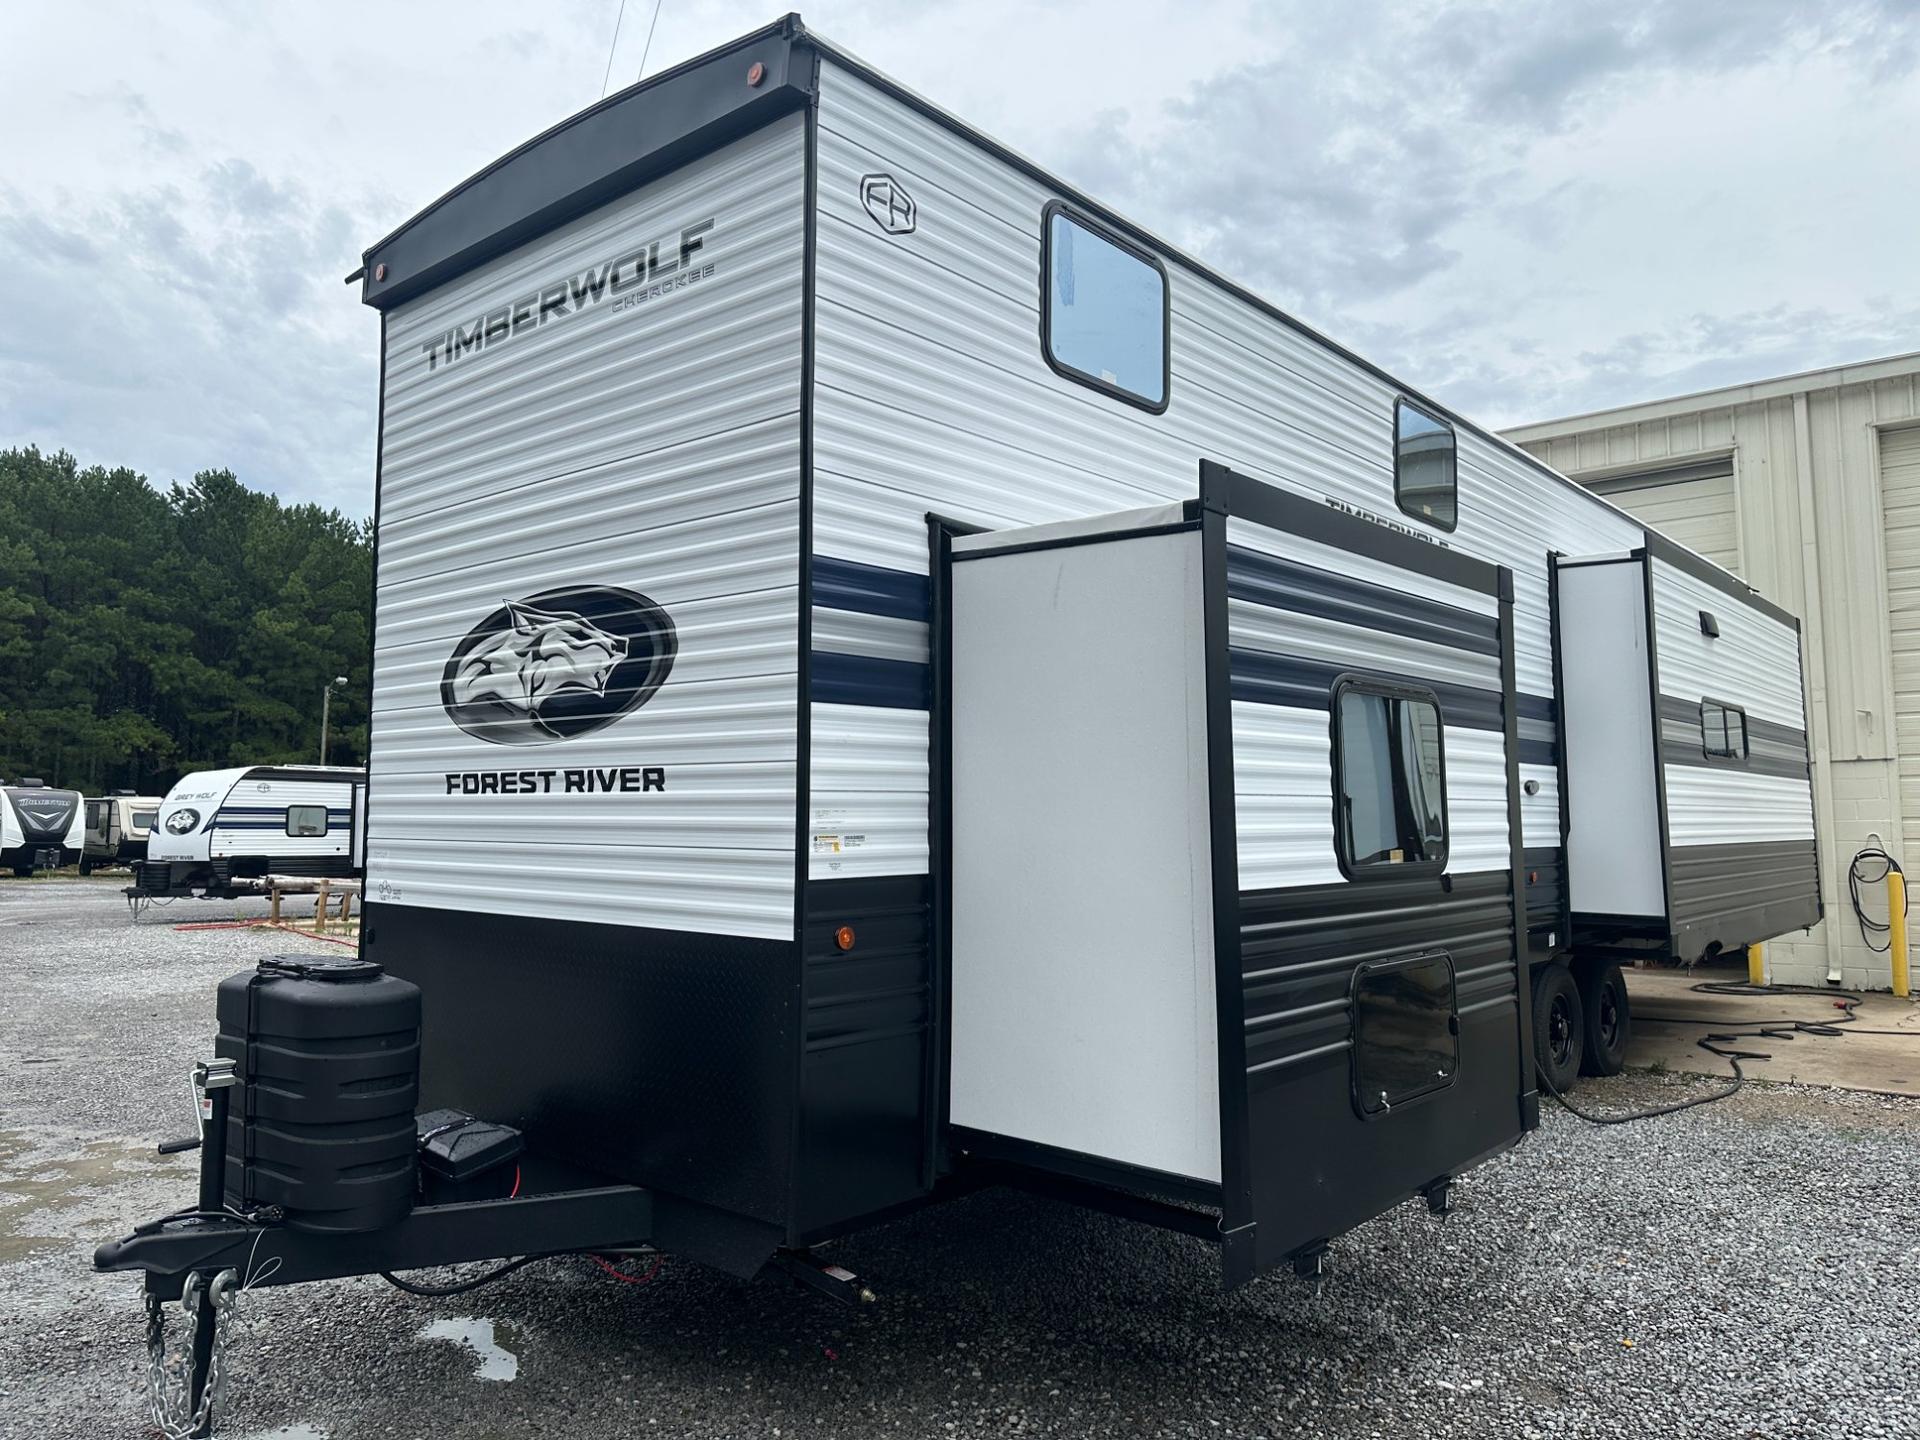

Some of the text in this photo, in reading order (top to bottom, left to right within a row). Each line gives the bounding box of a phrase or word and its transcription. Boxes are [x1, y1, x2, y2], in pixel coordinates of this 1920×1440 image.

[422, 217, 715, 372] TIMBERWOLF
[611, 262, 715, 313] CHEROKEE
[445, 767, 665, 794] FOREST RIVER
